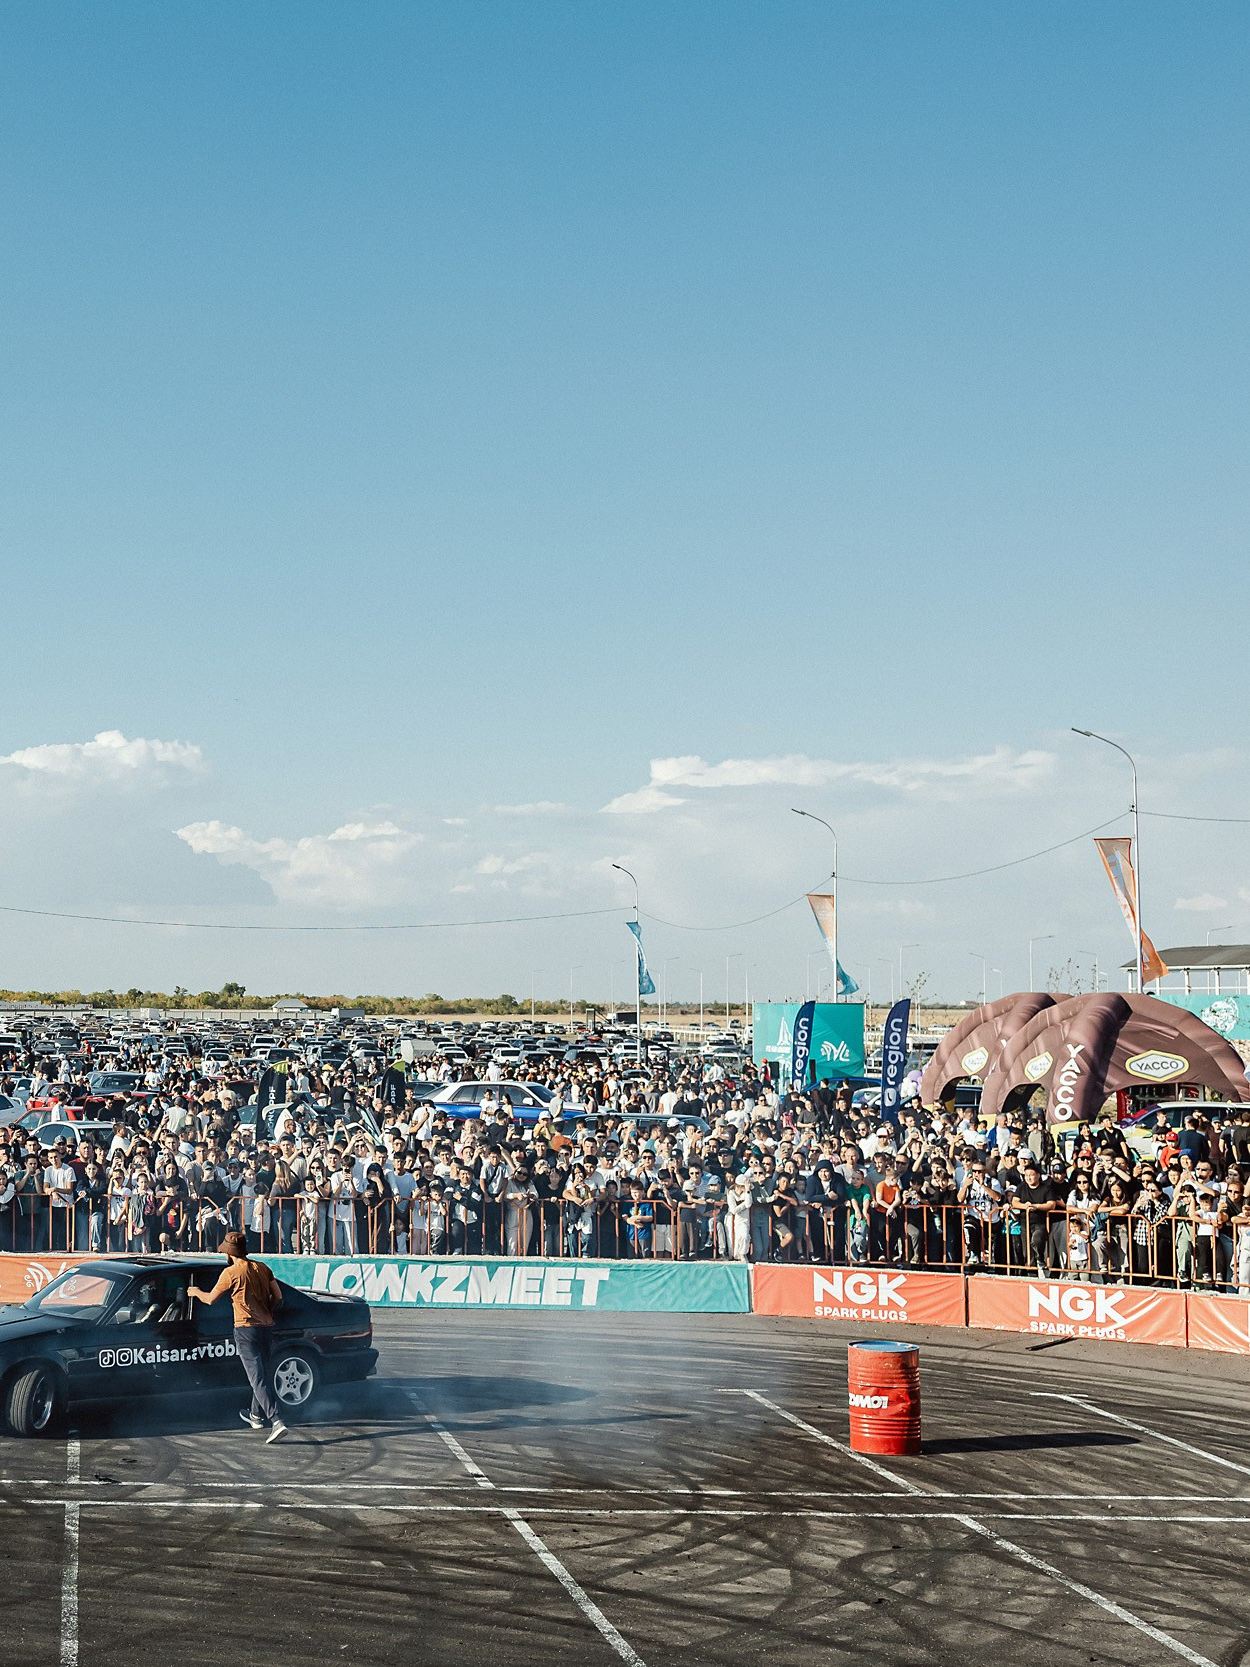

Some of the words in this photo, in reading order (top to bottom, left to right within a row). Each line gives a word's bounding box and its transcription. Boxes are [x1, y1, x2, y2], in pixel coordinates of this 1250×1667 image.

[794, 1017, 810, 1077] region
[885, 1018, 904, 1086] region
[1136, 1060, 1180, 1071] YACCO
[1054, 1044, 1086, 1121] YACCO
[813, 1271, 908, 1308] NGK
[1028, 1284, 1127, 1324] NGK
[814, 1306, 859, 1320] SPARK
[862, 1308, 908, 1321] PLUGS
[1030, 1320, 1076, 1335] SPARK
[1078, 1324, 1126, 1340] PLUGS
